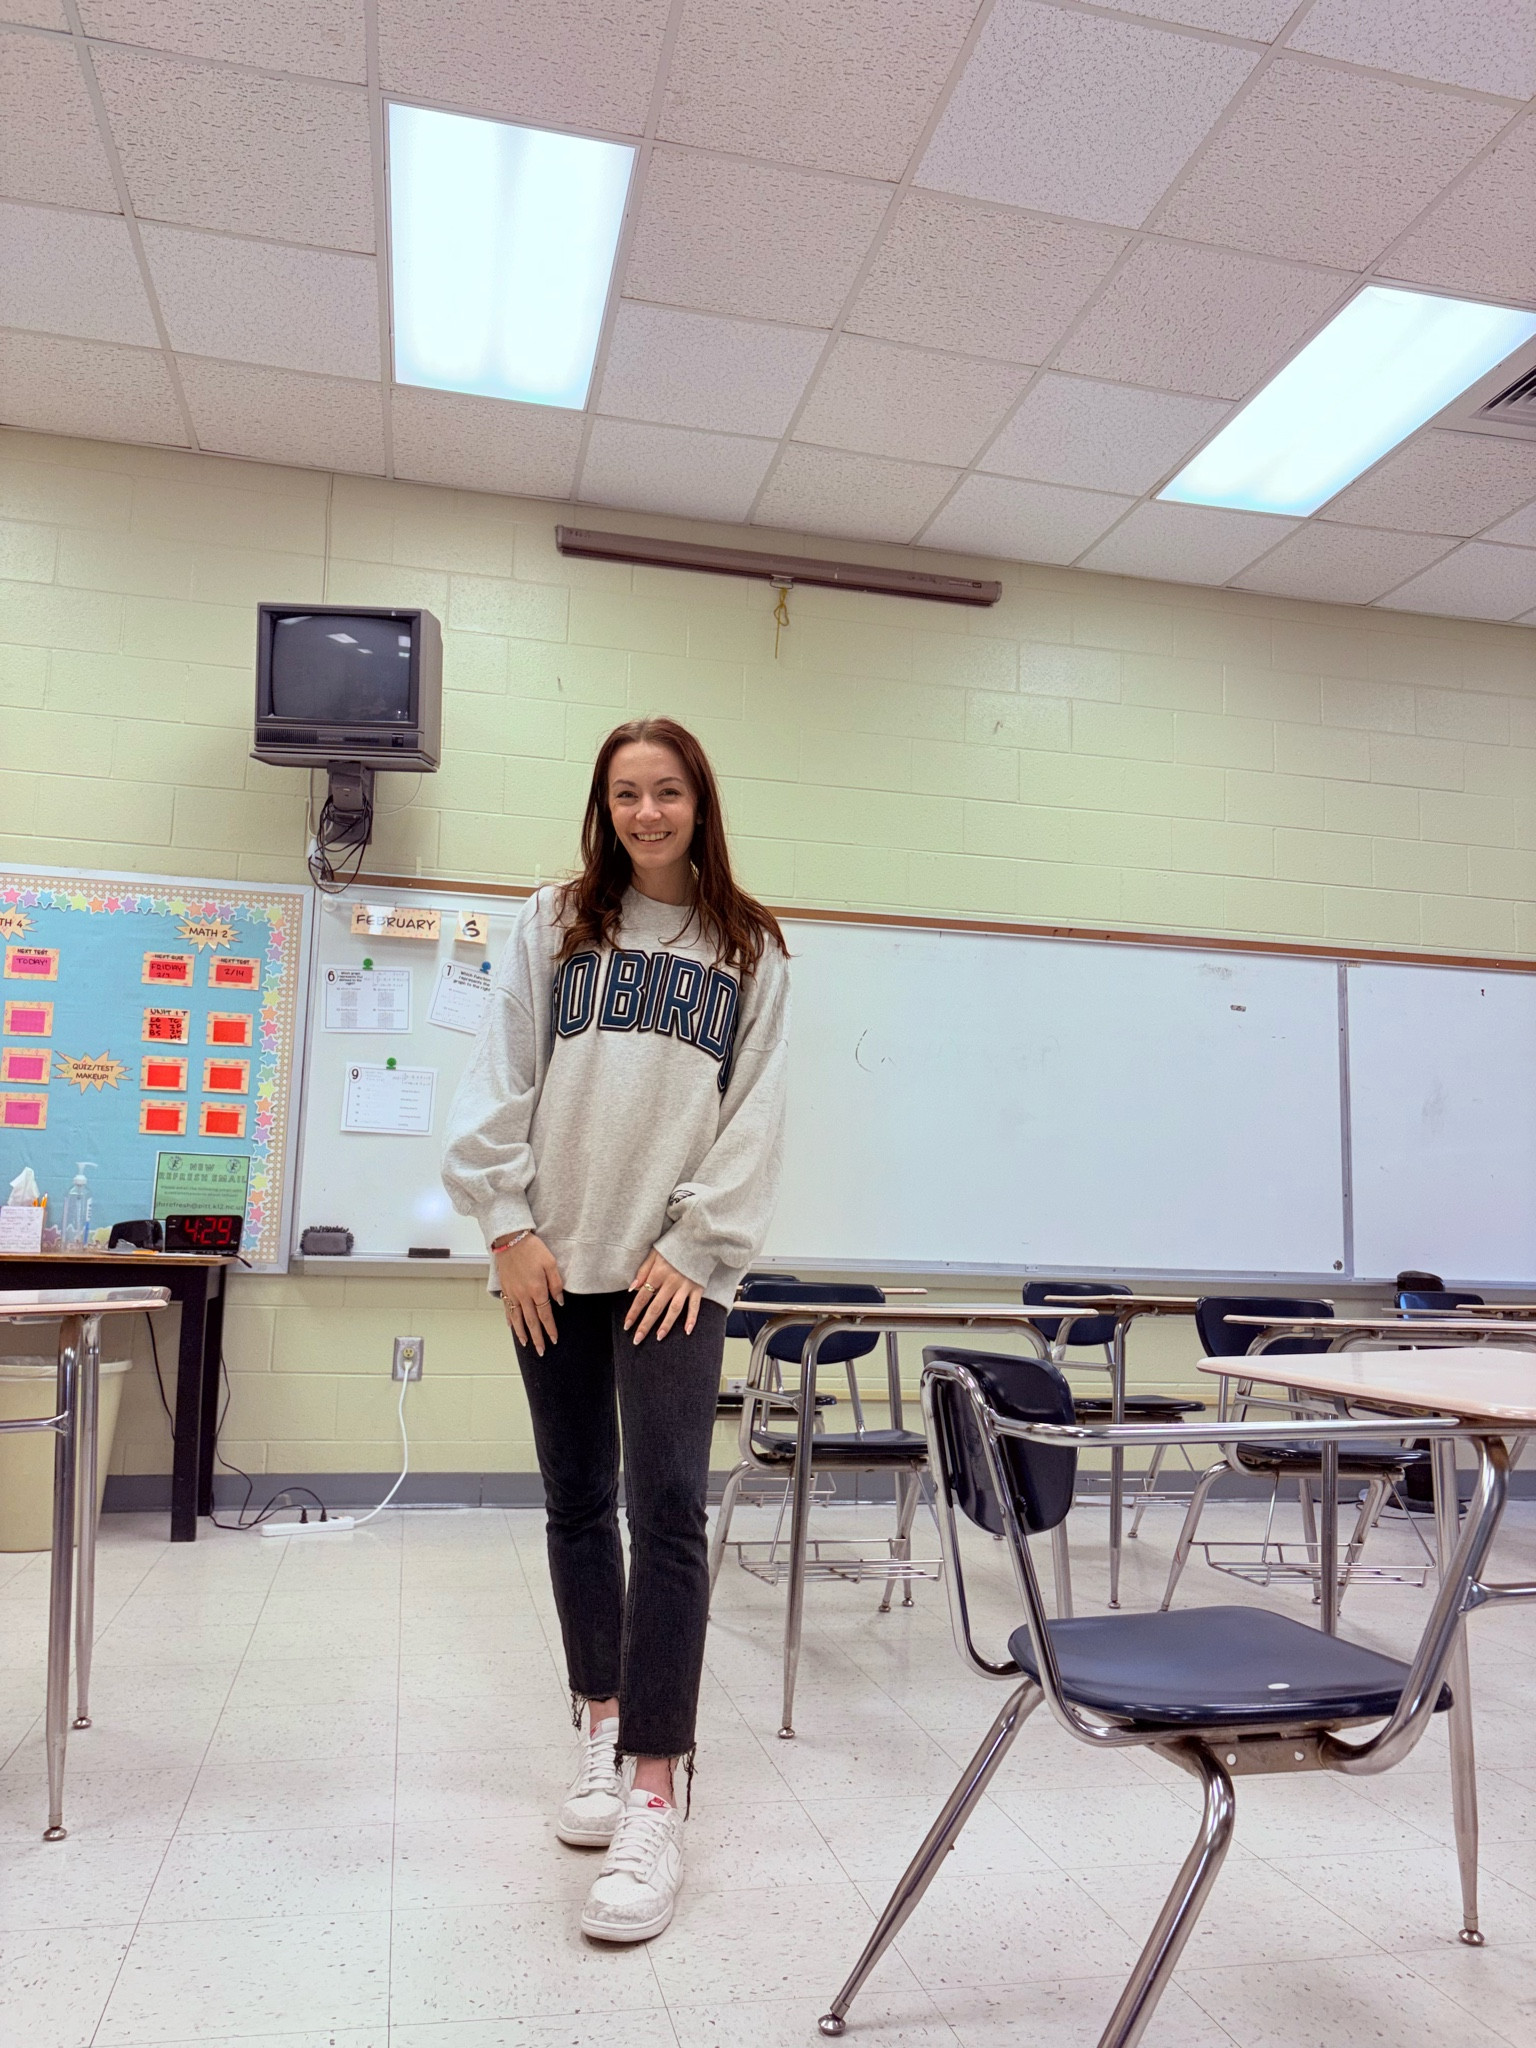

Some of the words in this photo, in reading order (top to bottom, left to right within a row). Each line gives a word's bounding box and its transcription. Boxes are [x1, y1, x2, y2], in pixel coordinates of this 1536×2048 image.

[16, 920, 23, 928] 4
[356, 914, 436, 931] FEBRUARY
[189, 927, 218, 937] MATH
[222, 930, 228, 938] 2
[16, 957, 48, 966] TODAY!
[151, 963, 186, 972] FRIDAY!
[224, 968, 244, 977] 2/14
[328, 970, 335, 981] 6
[597, 948, 740, 1092] BIRD
[72, 1063, 114, 1072] QUIZ/TEST
[75, 1072, 109, 1081] MAKEUP!
[351, 1068, 359, 1080] 9
[184, 1217, 233, 1245] 4:29
